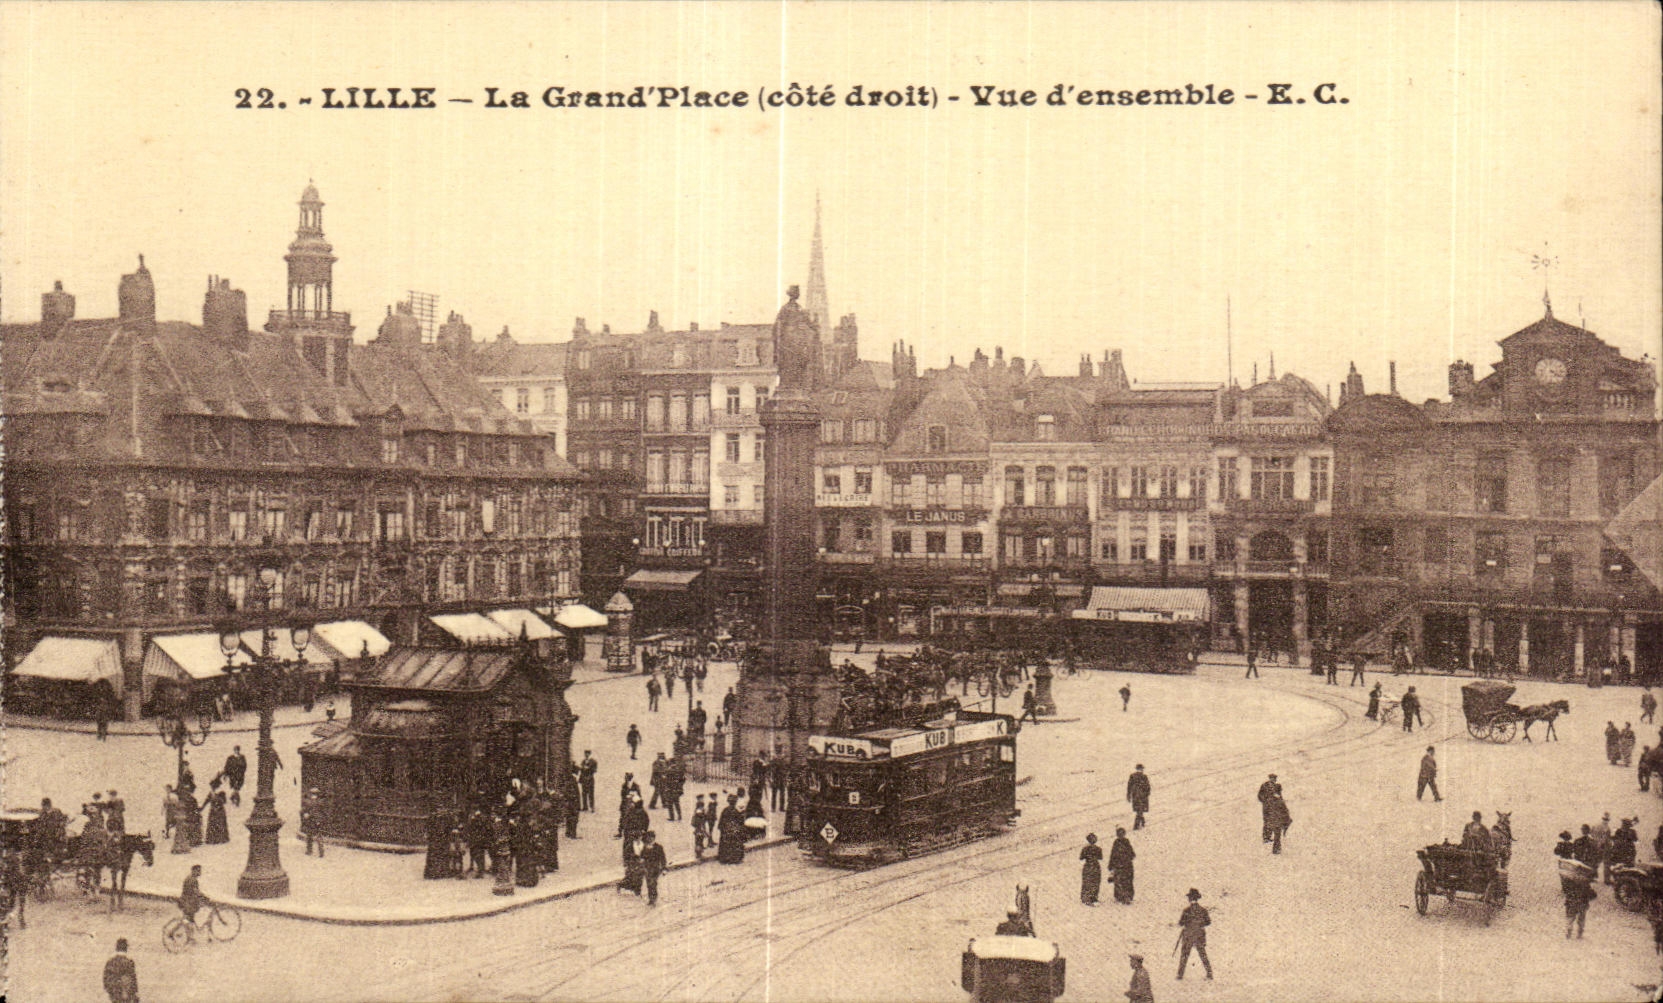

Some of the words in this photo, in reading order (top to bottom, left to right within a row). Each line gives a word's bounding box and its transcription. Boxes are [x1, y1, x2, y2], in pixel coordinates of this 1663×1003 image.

[887, 462, 988, 474] PHARMACIE
[906, 511, 922, 522] LE
[925, 511, 966, 523] JANUS
[924, 730, 946, 750] KUB
[824, 742, 855, 755] KUB
